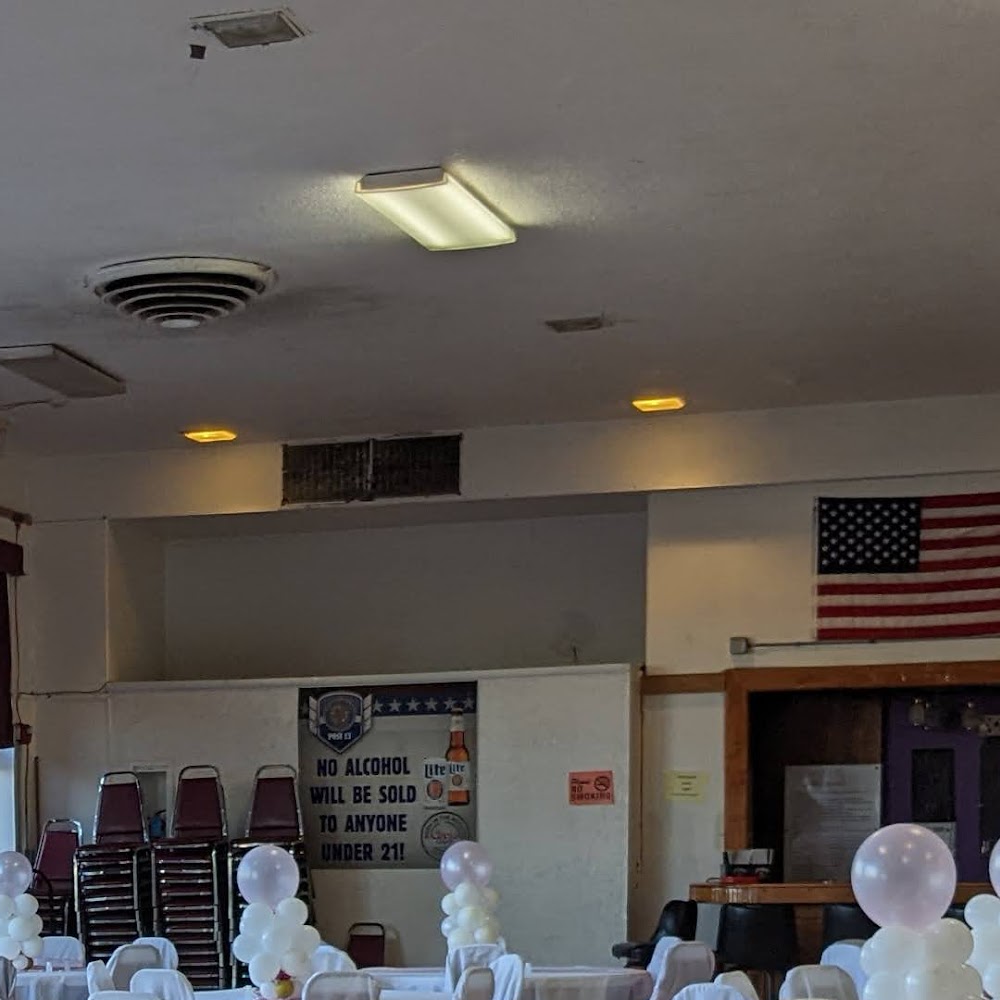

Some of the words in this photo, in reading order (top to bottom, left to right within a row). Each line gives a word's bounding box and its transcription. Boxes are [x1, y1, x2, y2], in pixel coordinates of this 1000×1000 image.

[317, 759, 337, 776] NO
[345, 757, 410, 776] ALCOHOL
[424, 763, 446, 779] Lite
[449, 763, 466, 775] Lite
[310, 786, 344, 804] WILL
[352, 785, 371, 804] BE
[379, 784, 417, 803] SOLD
[319, 815, 337, 833] TO
[345, 814, 407, 832] ANYONE
[321, 843, 373, 861] UNDER
[381, 844, 405, 861] 21!
